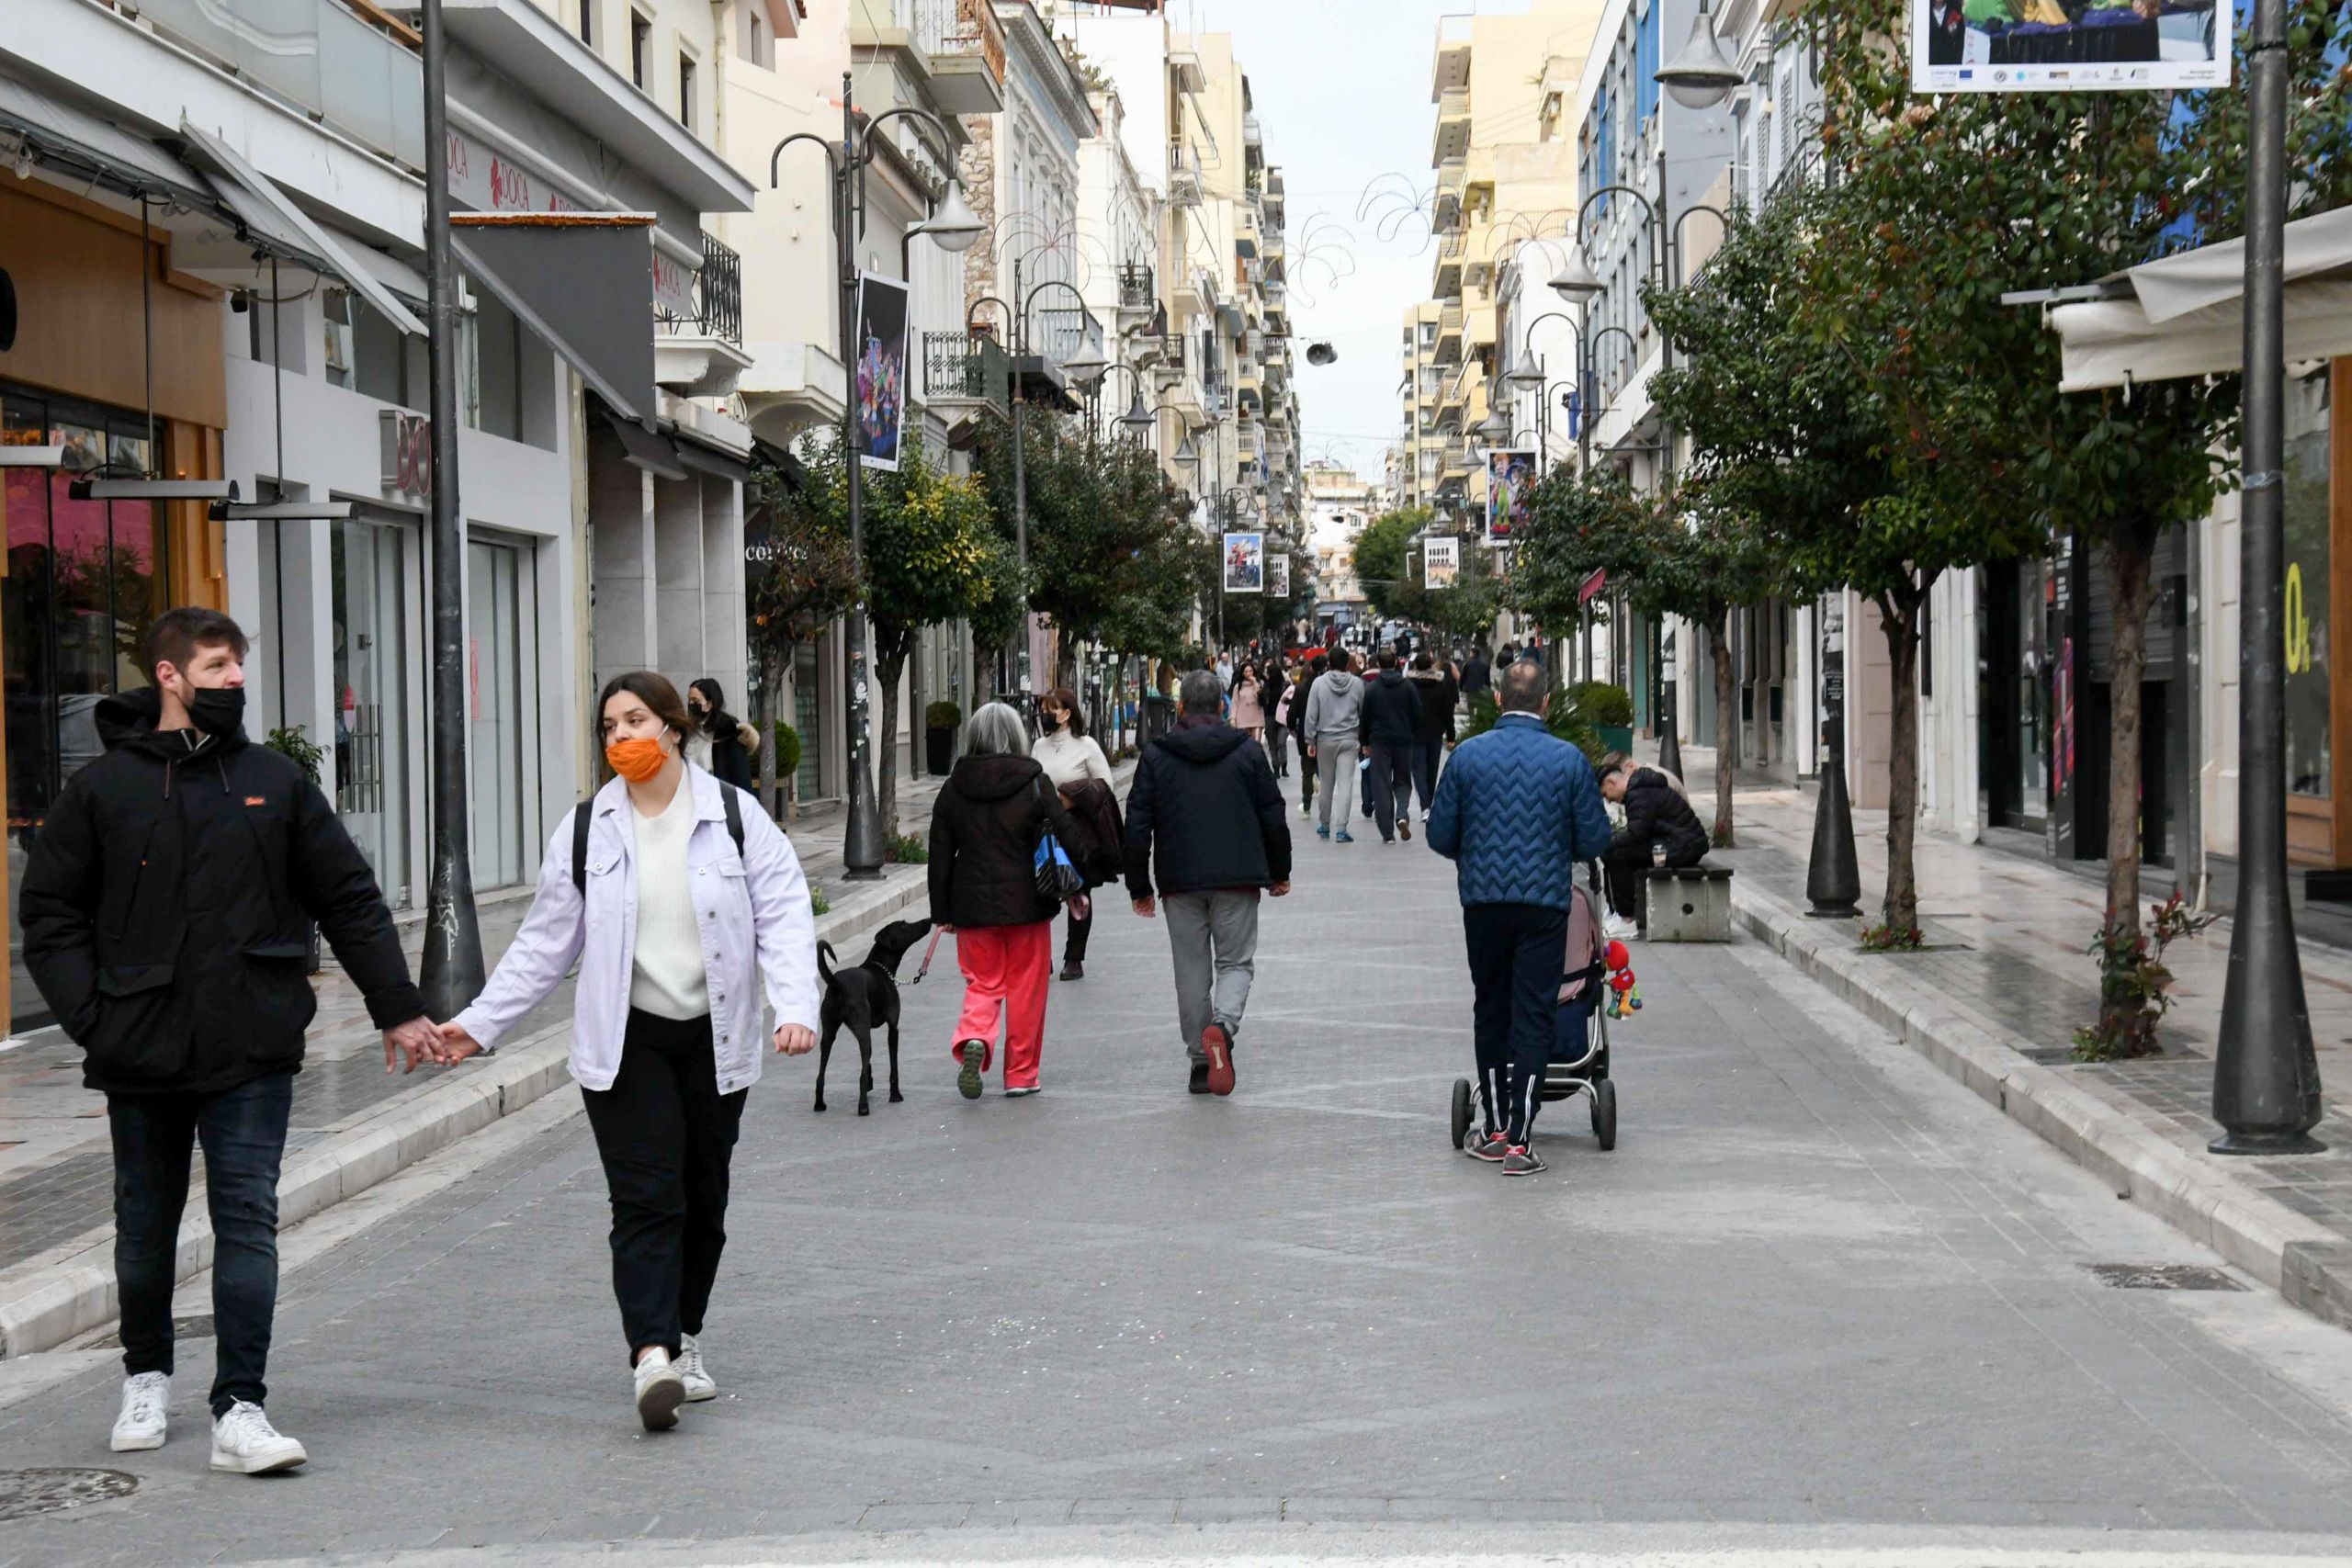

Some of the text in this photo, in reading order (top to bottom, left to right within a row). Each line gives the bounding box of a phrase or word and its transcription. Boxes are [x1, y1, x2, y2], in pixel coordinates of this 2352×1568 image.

[447, 132, 469, 178] OCA
[501, 162, 530, 211] DOCA
[396, 411, 432, 496] DO
[2284, 561, 2311, 674] 0%
